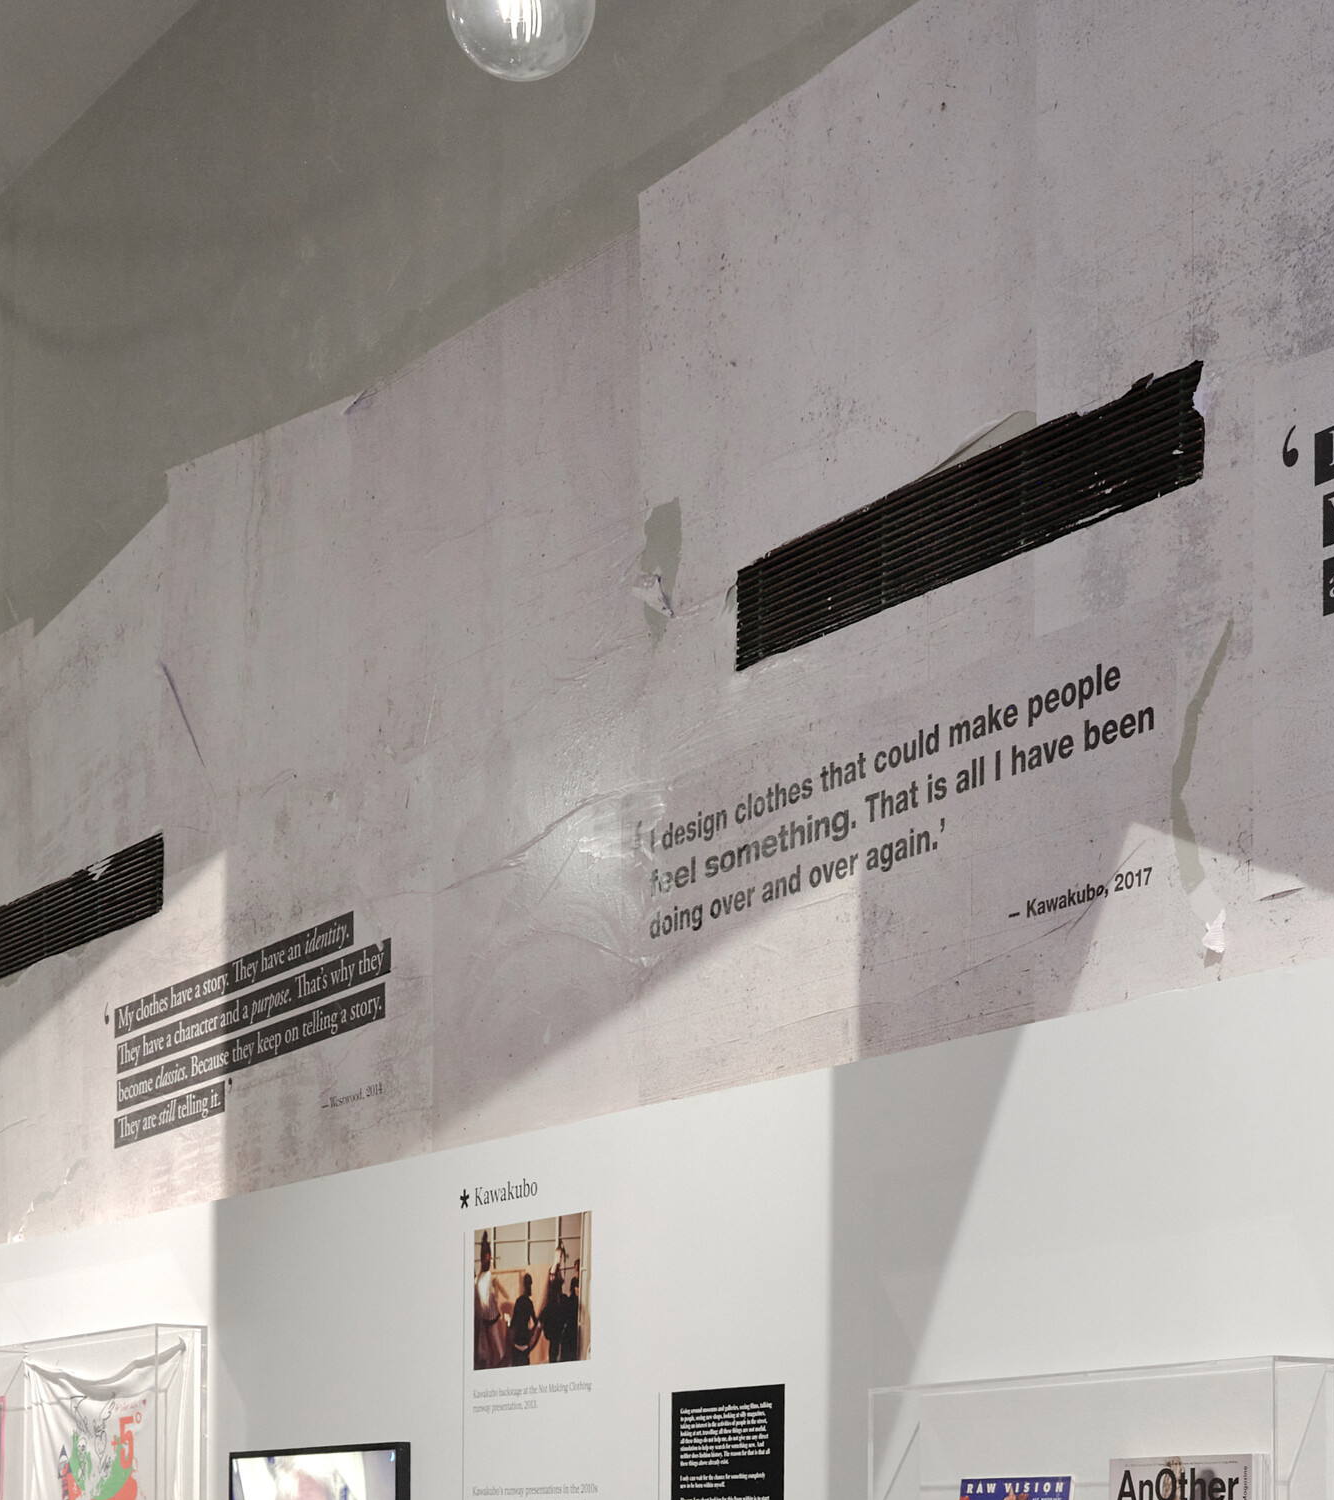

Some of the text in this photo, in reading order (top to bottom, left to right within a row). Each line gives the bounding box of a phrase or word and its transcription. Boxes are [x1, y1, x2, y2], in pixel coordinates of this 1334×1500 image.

[651, 707, 1154, 896] feel something. That is all I have been
[662, 810, 727, 850] design
[735, 778, 813, 824] clothes
[820, 752, 866, 792] that
[874, 724, 939, 773] could
[950, 704, 1018, 747] make
[1028, 667, 1120, 727] people
[650, 904, 703, 939] doing
[710, 887, 755, 919] over
[762, 864, 801, 903] and
[809, 853, 858, 888] over
[1027, 882, 1109, 918] Kawakubo,
[1114, 867, 1152, 892] 2017
[118, 1043, 140, 1066] They
[143, 1036, 164, 1056] have
[166, 1034, 171, 1047] a
[174, 1016, 218, 1044] character
[220, 1000, 239, 1027] and
[243, 1005, 248, 1019] a
[250, 989, 291, 1023] purpose.
[331, 959, 355, 986] why
[359, 950, 385, 976] they
[474, 1178, 539, 1207] Kawakubo
[966, 1482, 1064, 1494] RAW VISION
